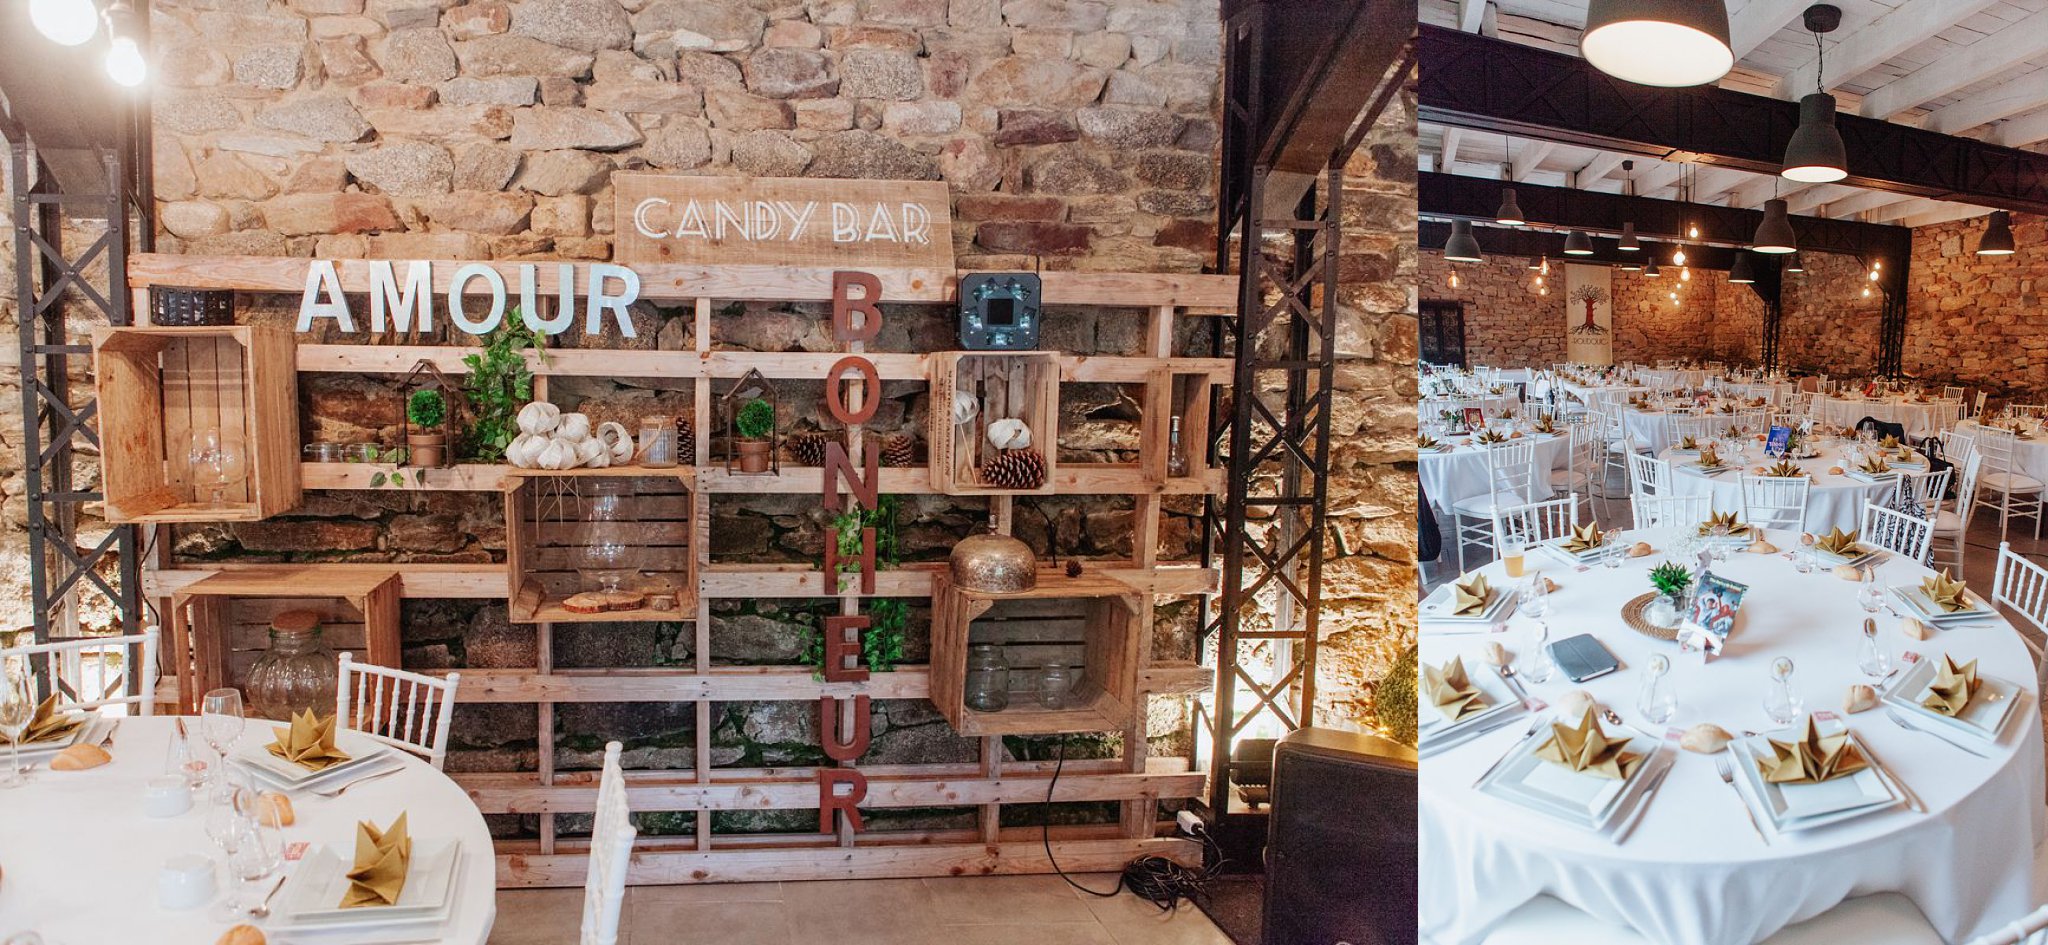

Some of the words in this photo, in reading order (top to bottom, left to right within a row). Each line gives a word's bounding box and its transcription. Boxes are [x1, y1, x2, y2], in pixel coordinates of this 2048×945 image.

[634, 197, 819, 241] CANDY
[832, 201, 931, 245] BAR
[295, 260, 640, 338] AMOUR
[819, 270, 883, 834] BONHEUR
